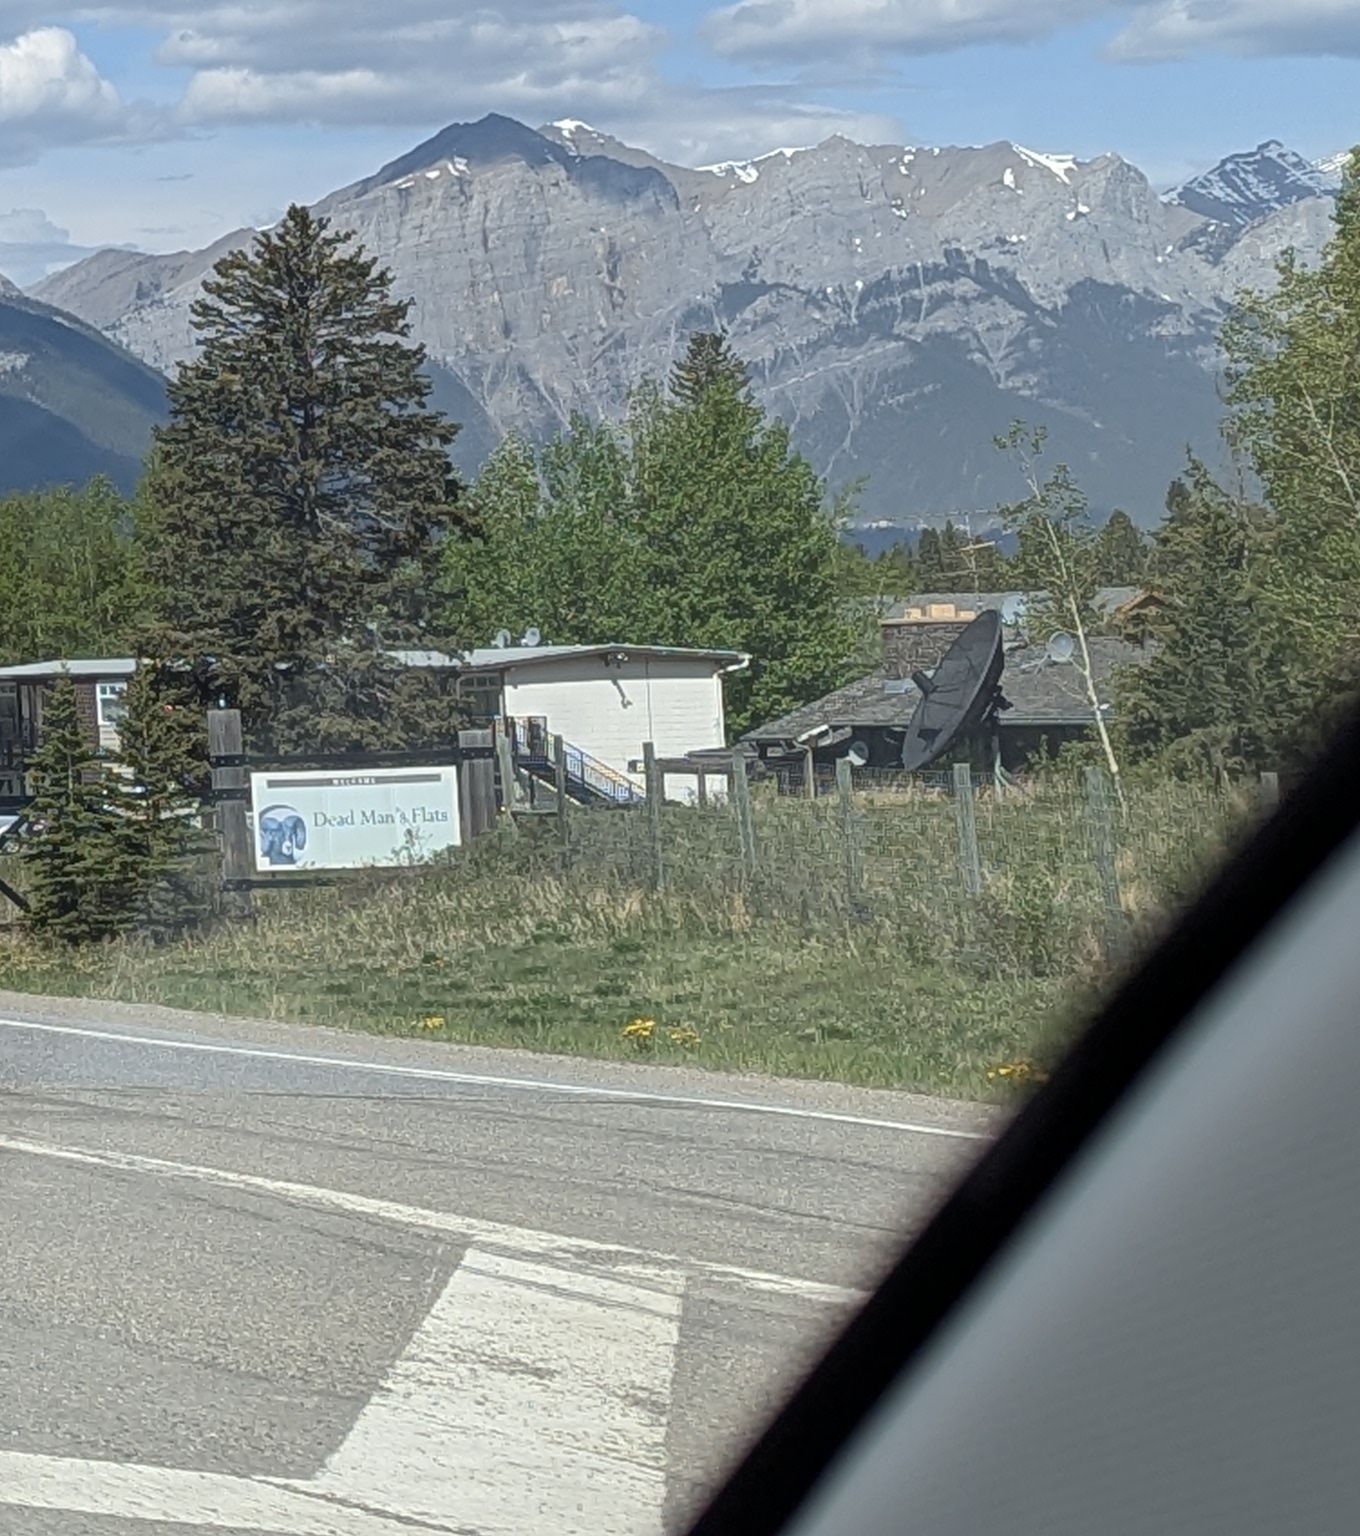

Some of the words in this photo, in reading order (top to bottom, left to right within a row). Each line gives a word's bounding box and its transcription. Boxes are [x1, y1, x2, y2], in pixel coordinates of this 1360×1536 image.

[314, 809, 355, 827] Dead
[361, 806, 407, 825] Man's
[412, 806, 448, 823] Flats
